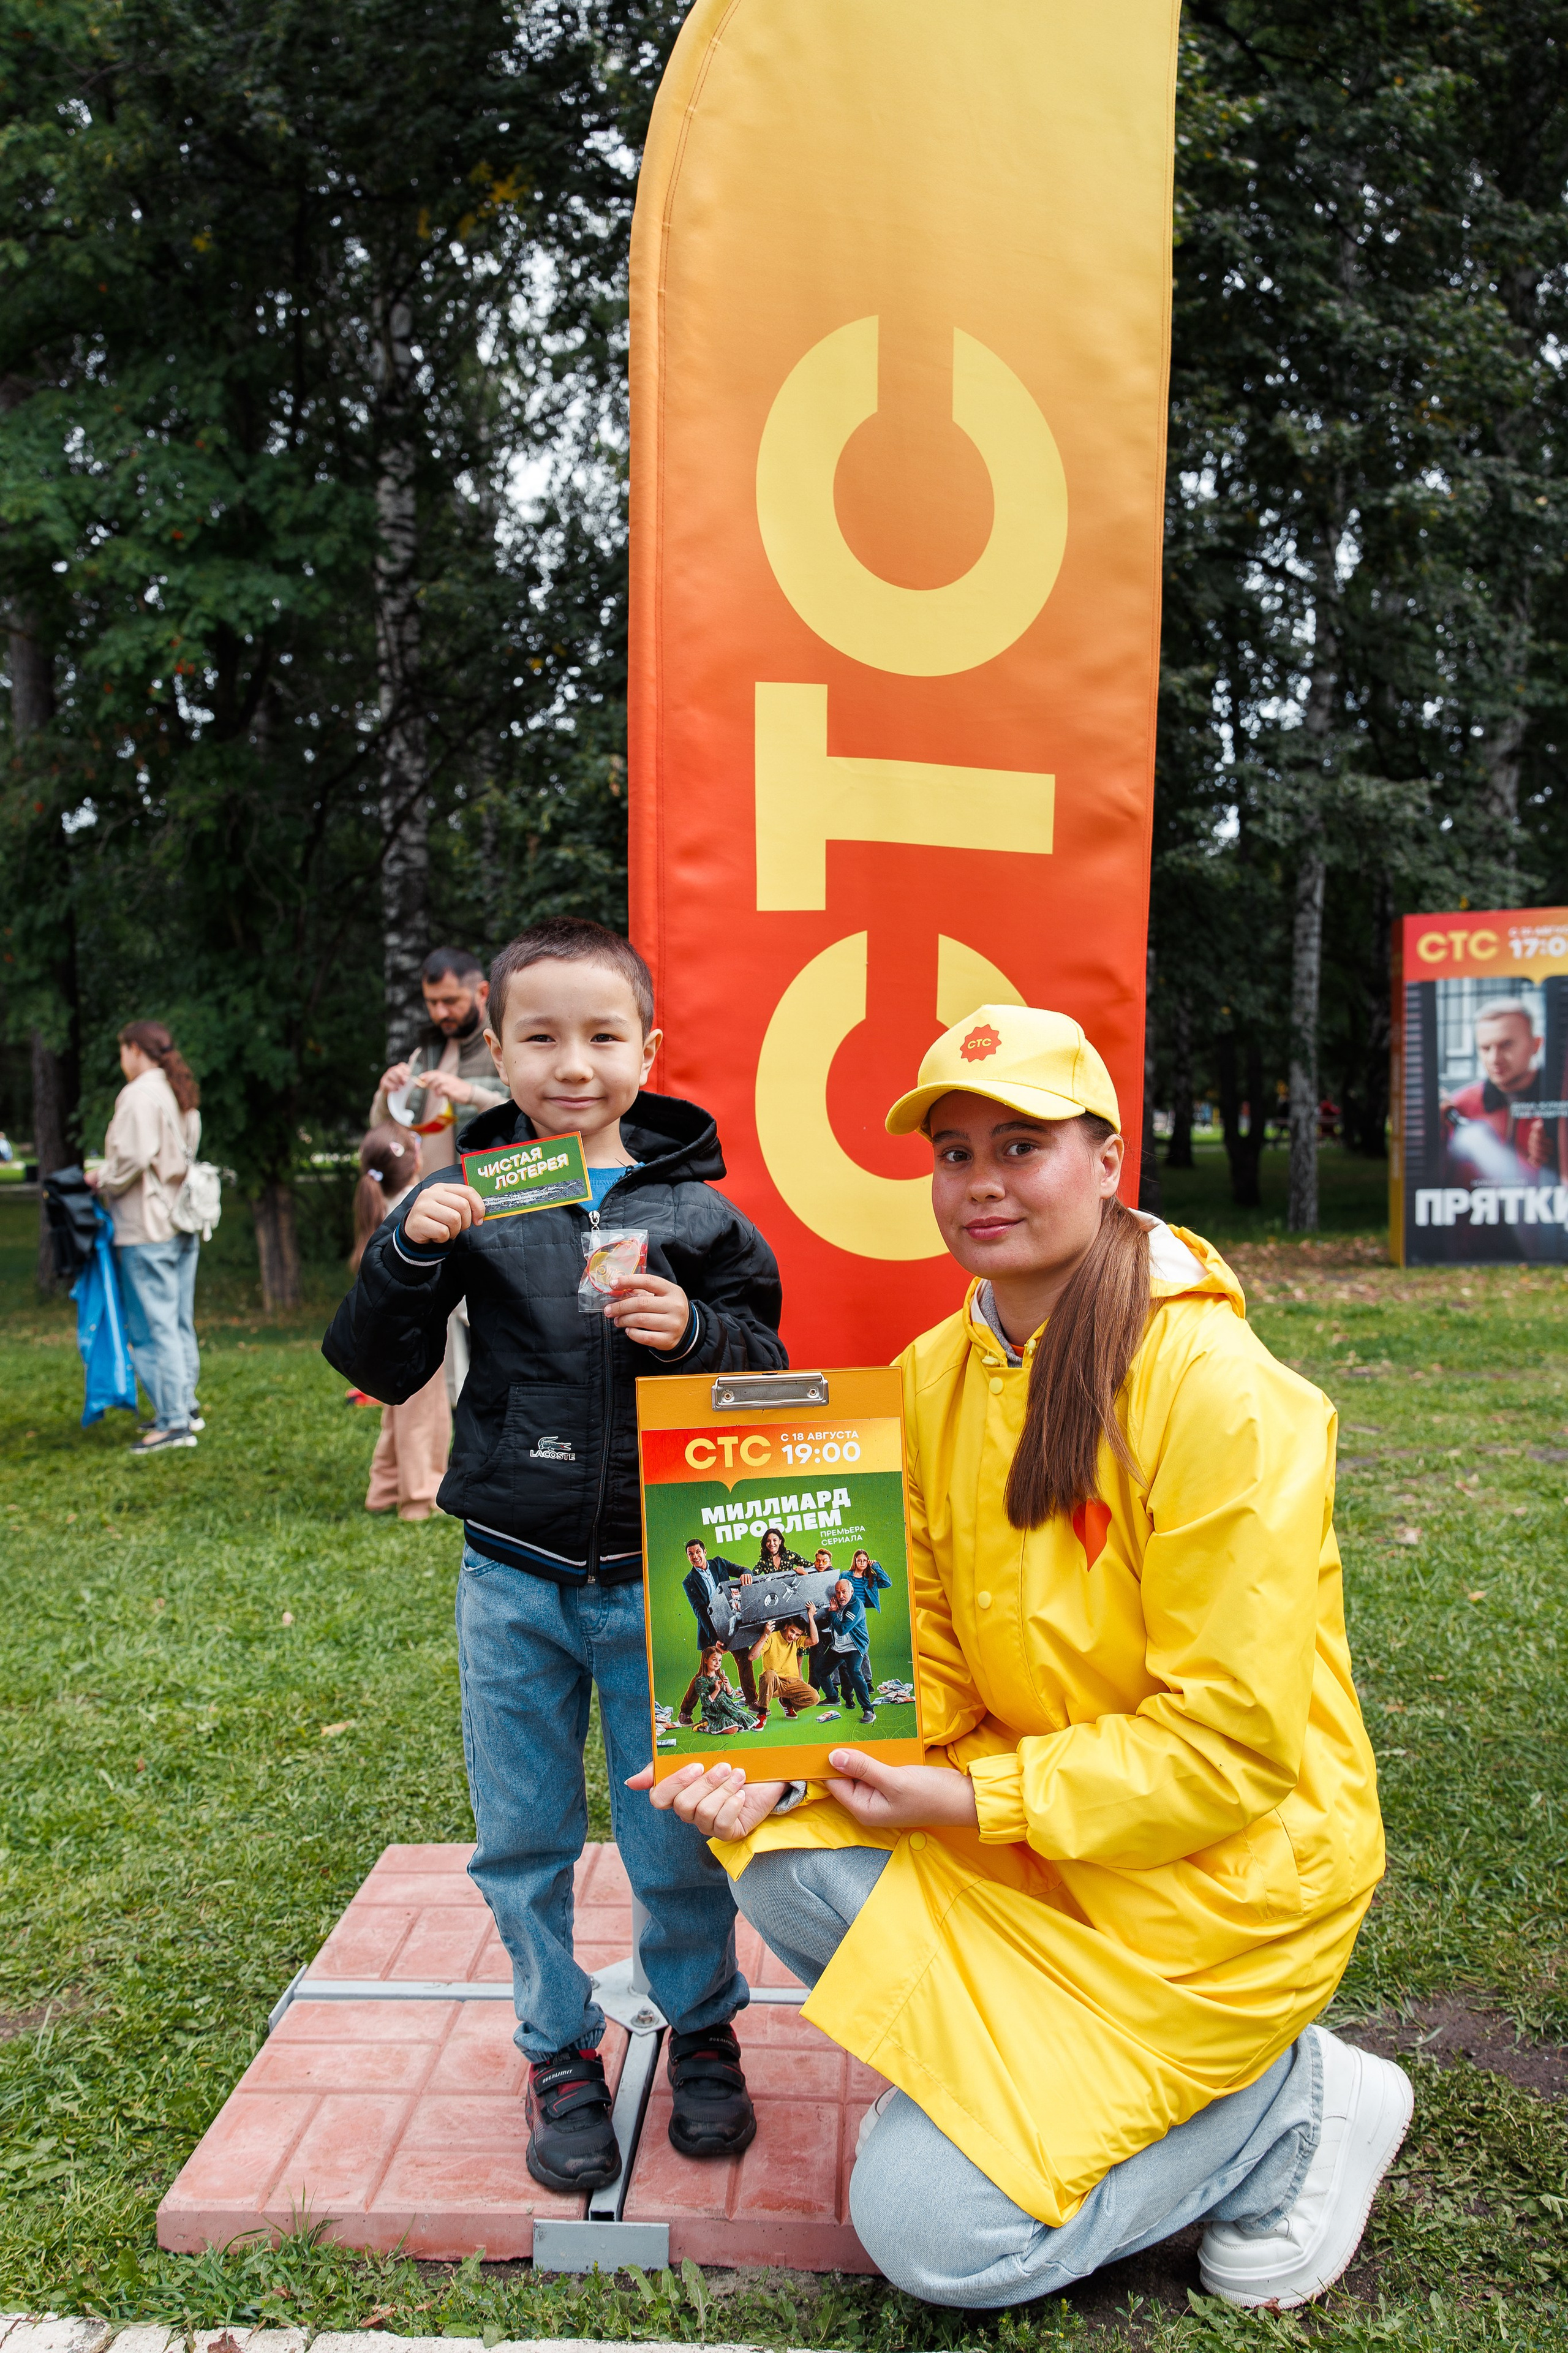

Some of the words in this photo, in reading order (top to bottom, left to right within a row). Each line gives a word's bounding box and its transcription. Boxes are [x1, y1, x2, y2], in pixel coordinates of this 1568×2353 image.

[755, 315, 1068, 1260] СТС
[1416, 929, 1498, 964] СТС
[1509, 937, 1568, 959] 17:0
[967, 1038, 992, 1049] СТС
[477, 1146, 543, 1177] ЧИСТАЯ
[495, 1153, 569, 1190] ЛОТЕРЕЯ
[780, 1433, 789, 1441] С
[792, 1432, 804, 1441] 18
[807, 1430, 859, 1440] АВГУСТА
[530, 1449, 576, 1460] LACOSTE
[685, 1435, 772, 1470] СТС
[782, 1441, 861, 1465] 19:00
[701, 1487, 851, 1525] МИЛЛИАРД
[715, 1509, 842, 1543] ПРОБЛЕМ
[820, 1525, 865, 1538] ПРЕМЬЕРА
[821, 1534, 863, 1546] СЕРИАЛА
